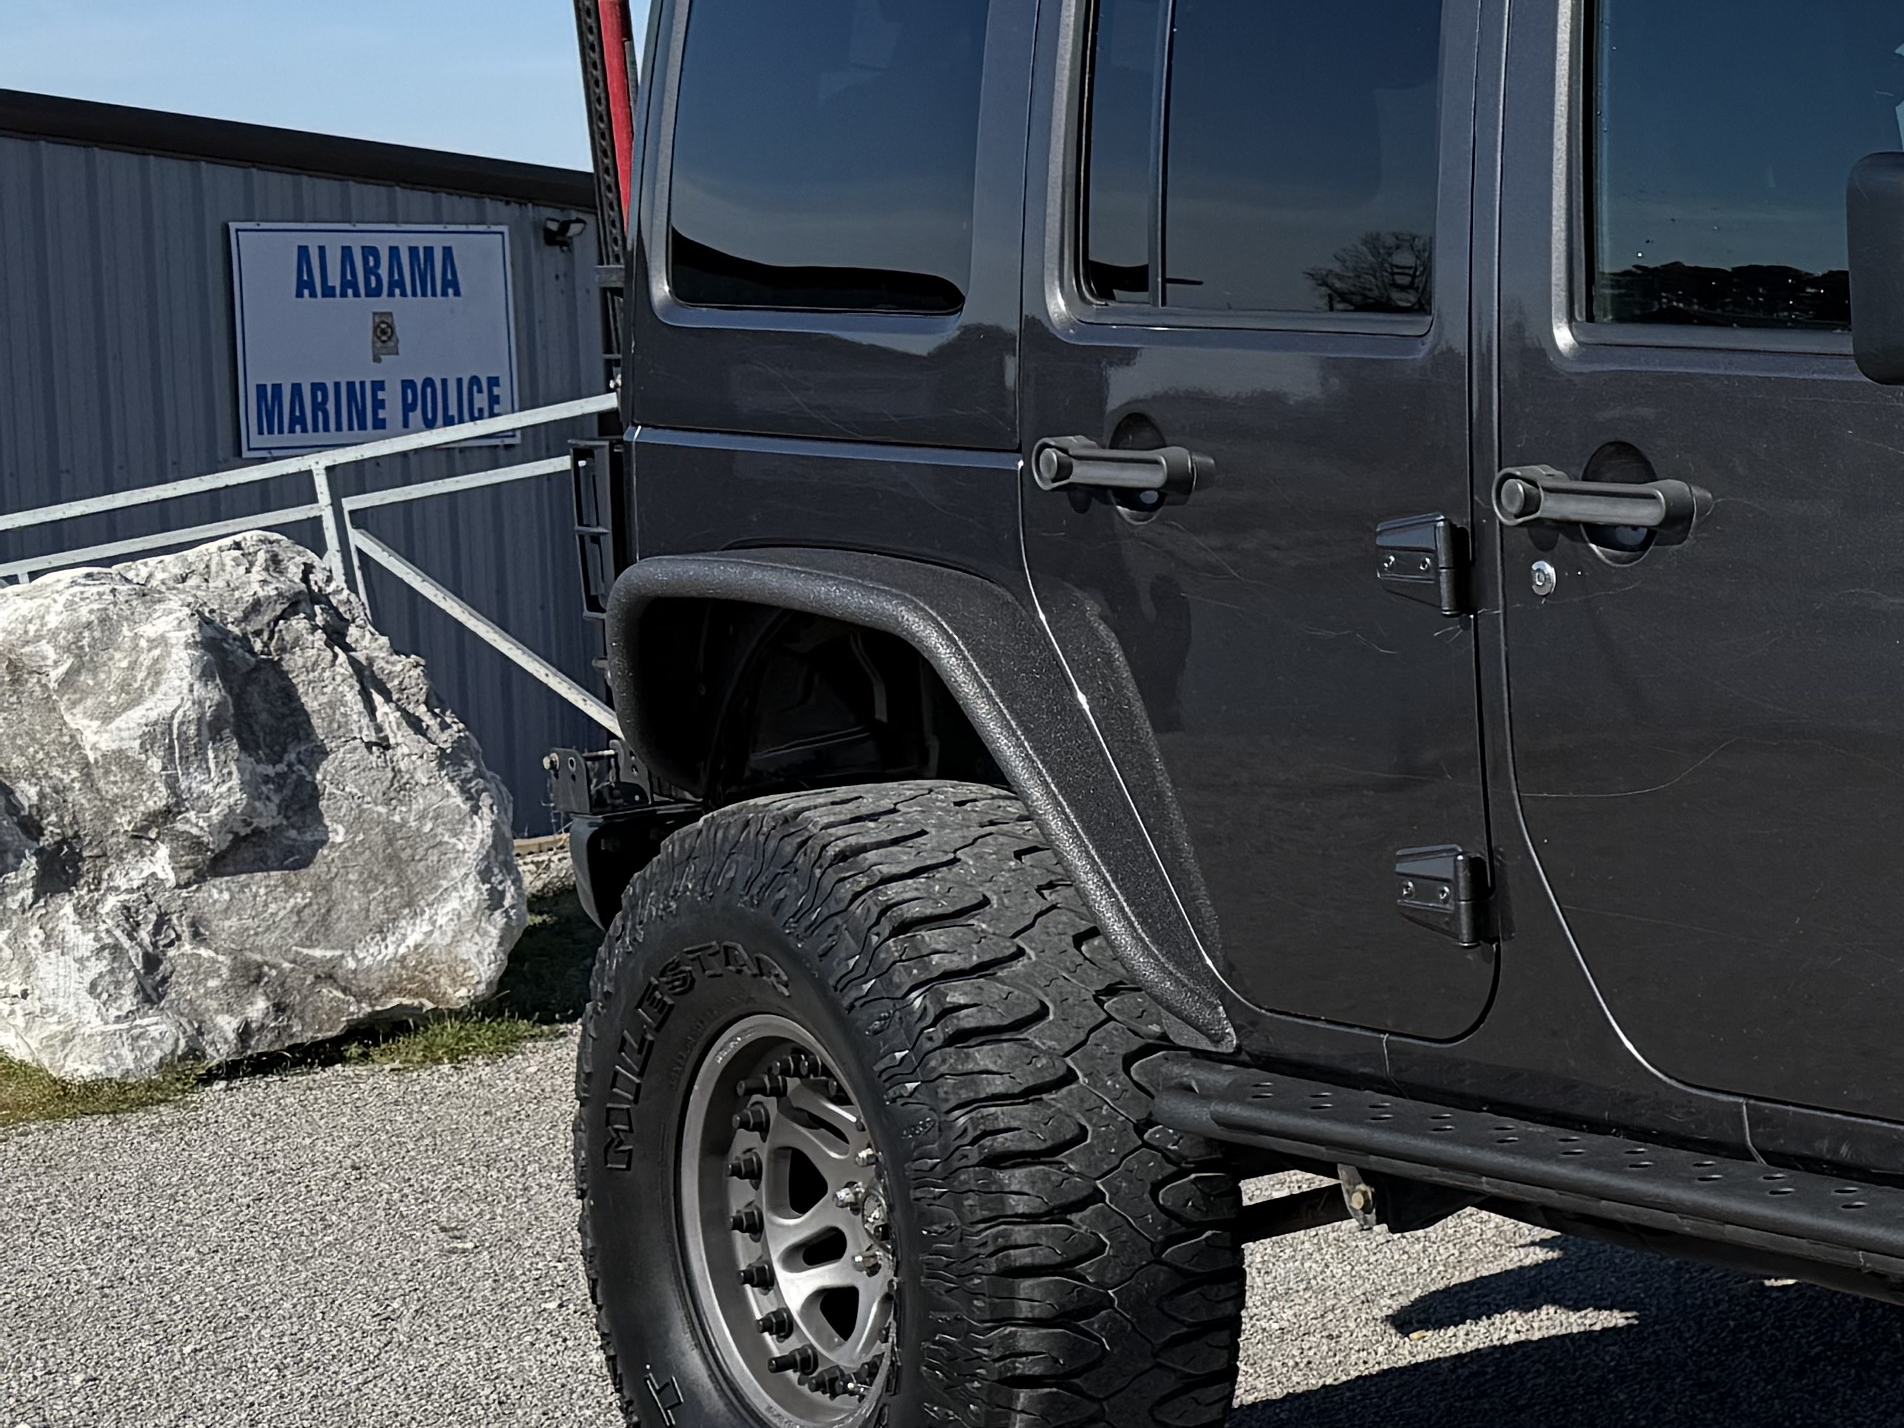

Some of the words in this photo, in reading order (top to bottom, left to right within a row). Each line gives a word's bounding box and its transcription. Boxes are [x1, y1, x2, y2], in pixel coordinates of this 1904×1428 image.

[295, 244, 461, 299] ALABAMA
[255, 380, 387, 435] MARINE
[401, 375, 501, 429] POLICE
[603, 941, 792, 1172] MILESTAR
